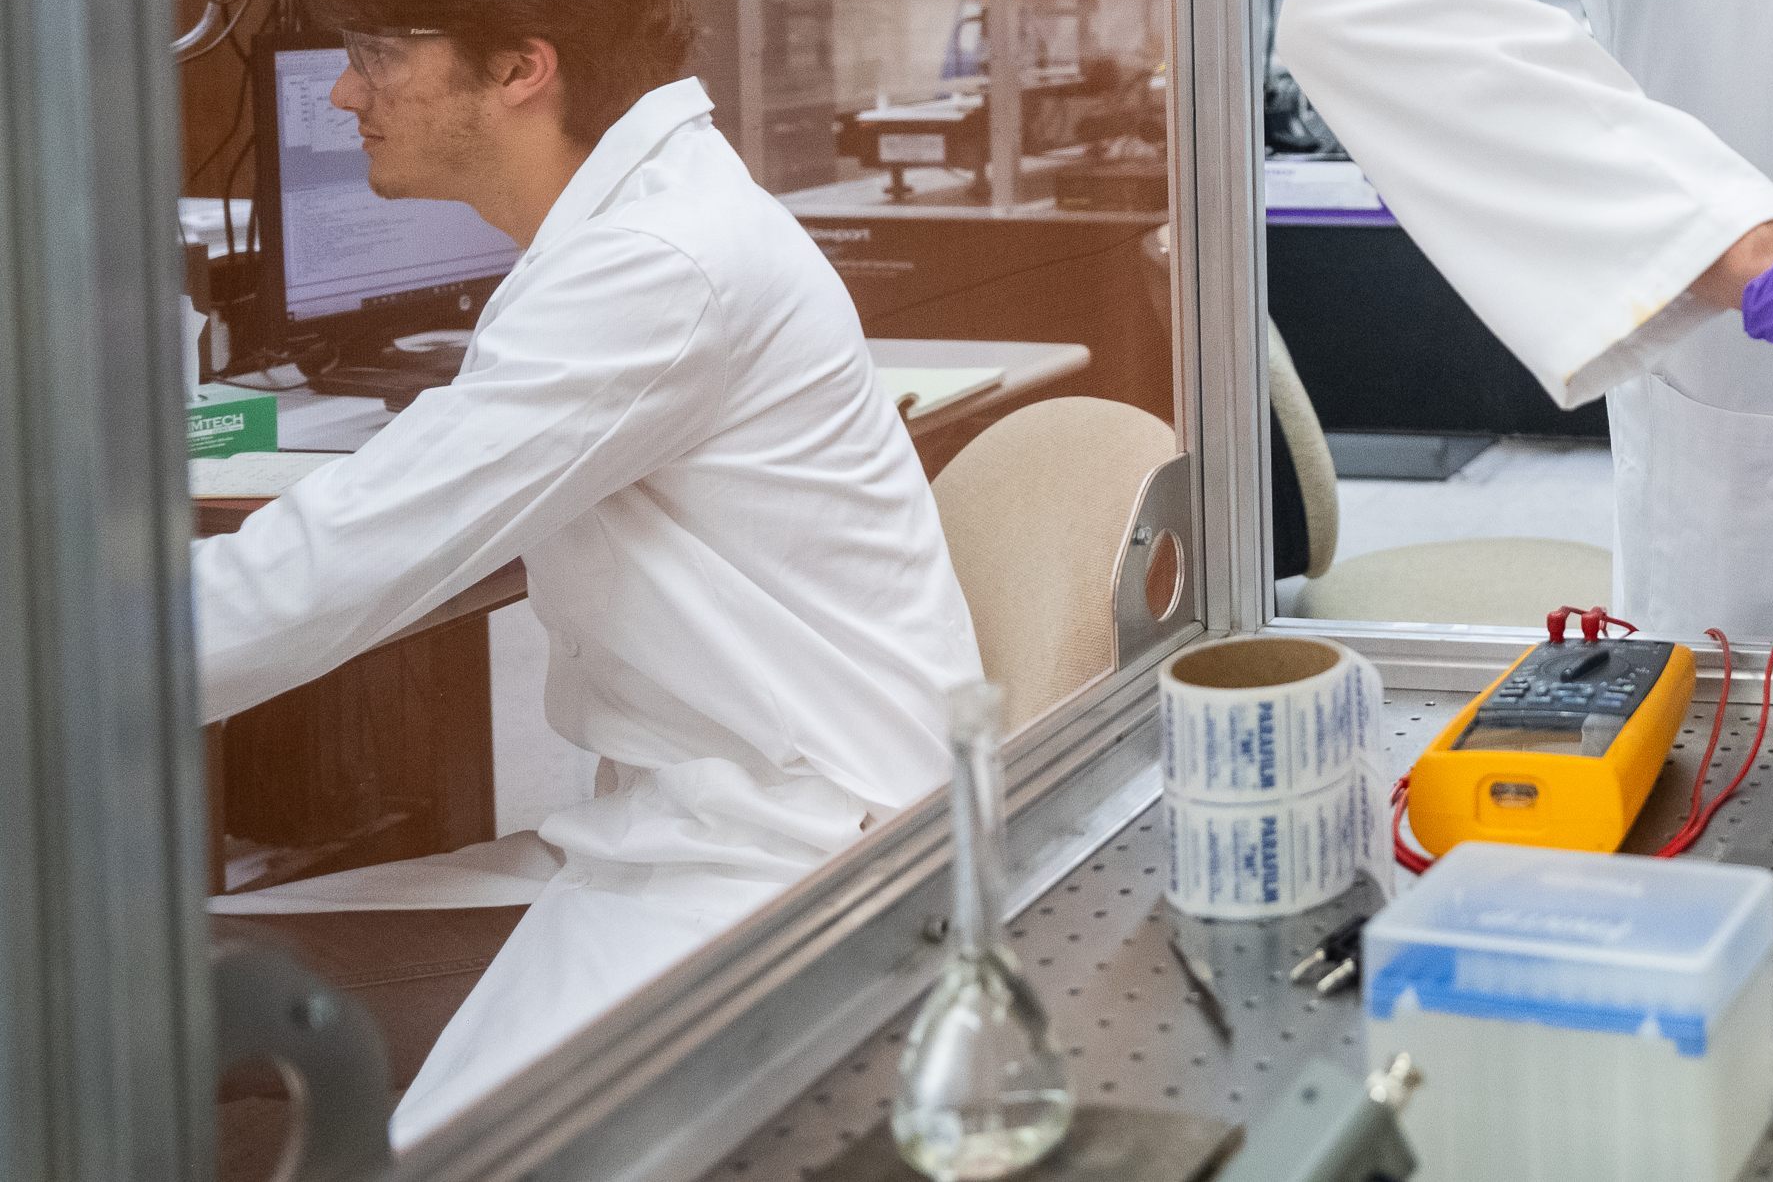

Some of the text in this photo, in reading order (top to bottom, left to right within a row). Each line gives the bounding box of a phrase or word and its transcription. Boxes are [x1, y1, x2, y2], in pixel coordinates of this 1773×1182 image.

[186, 413, 244, 433] IMTECH
[1257, 700, 1275, 790] PARAFILM
[1260, 815, 1279, 904] PARAFILM
